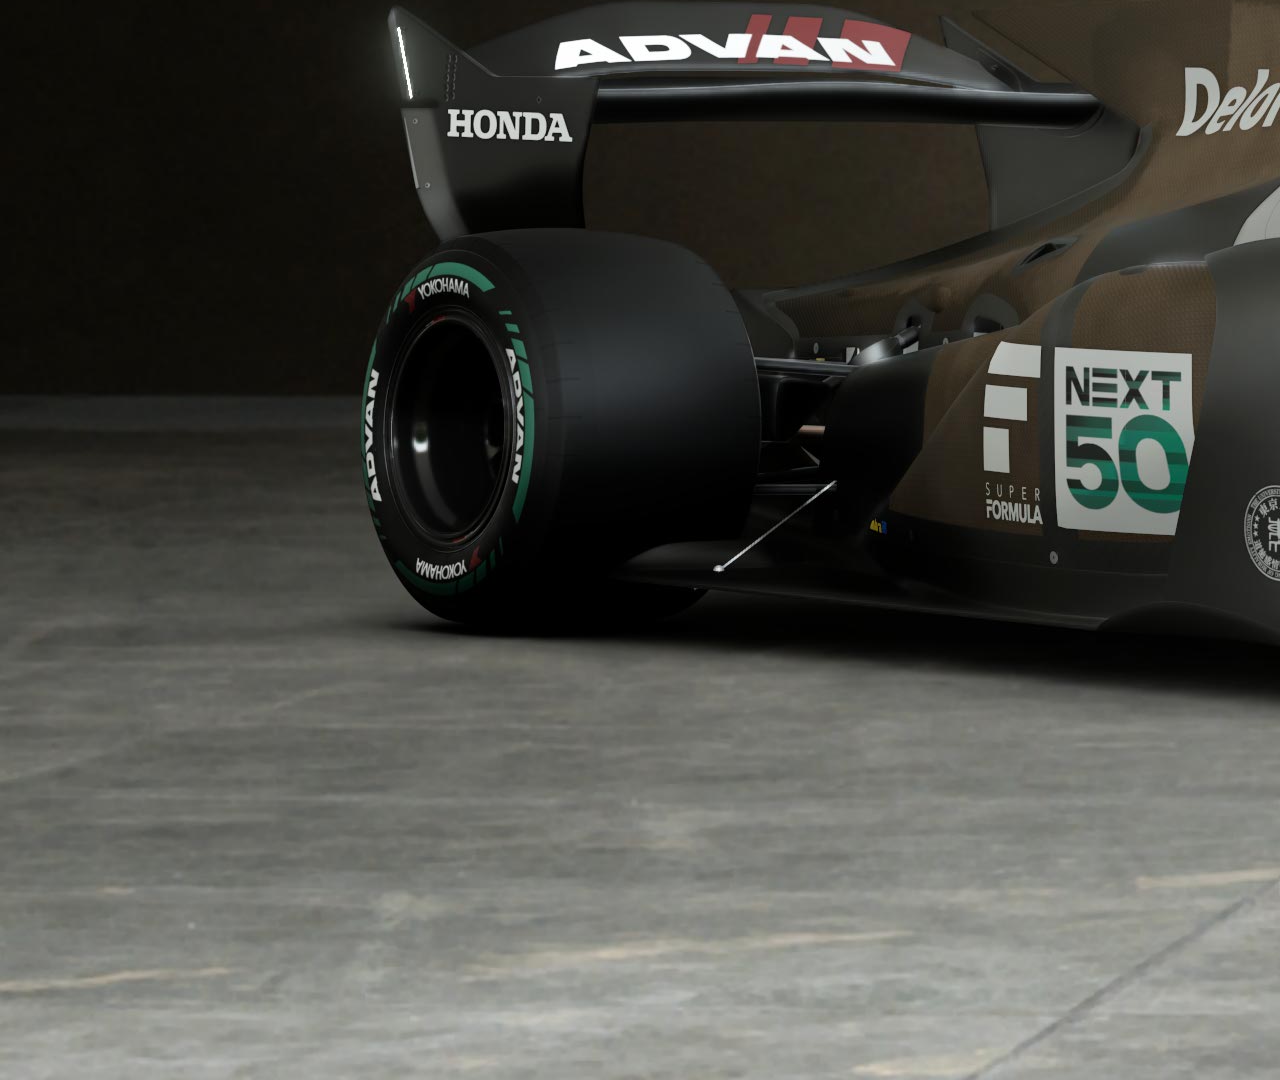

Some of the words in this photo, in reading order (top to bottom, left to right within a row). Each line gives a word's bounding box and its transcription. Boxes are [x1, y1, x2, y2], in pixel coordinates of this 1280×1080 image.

[554, 33, 896, 70] ADVAN
[447, 109, 573, 143] HONDA
[417, 276, 470, 300] YOKOHAMA
[1066, 366, 1182, 411] NEXT
[505, 348, 526, 484] ADVAN
[364, 368, 382, 503] ADVAN
[1066, 414, 1190, 514] 50
[985, 482, 1041, 502] SUPER
[985, 498, 1044, 525] FORMULA
[415, 558, 468, 580] YOKOHAMA
